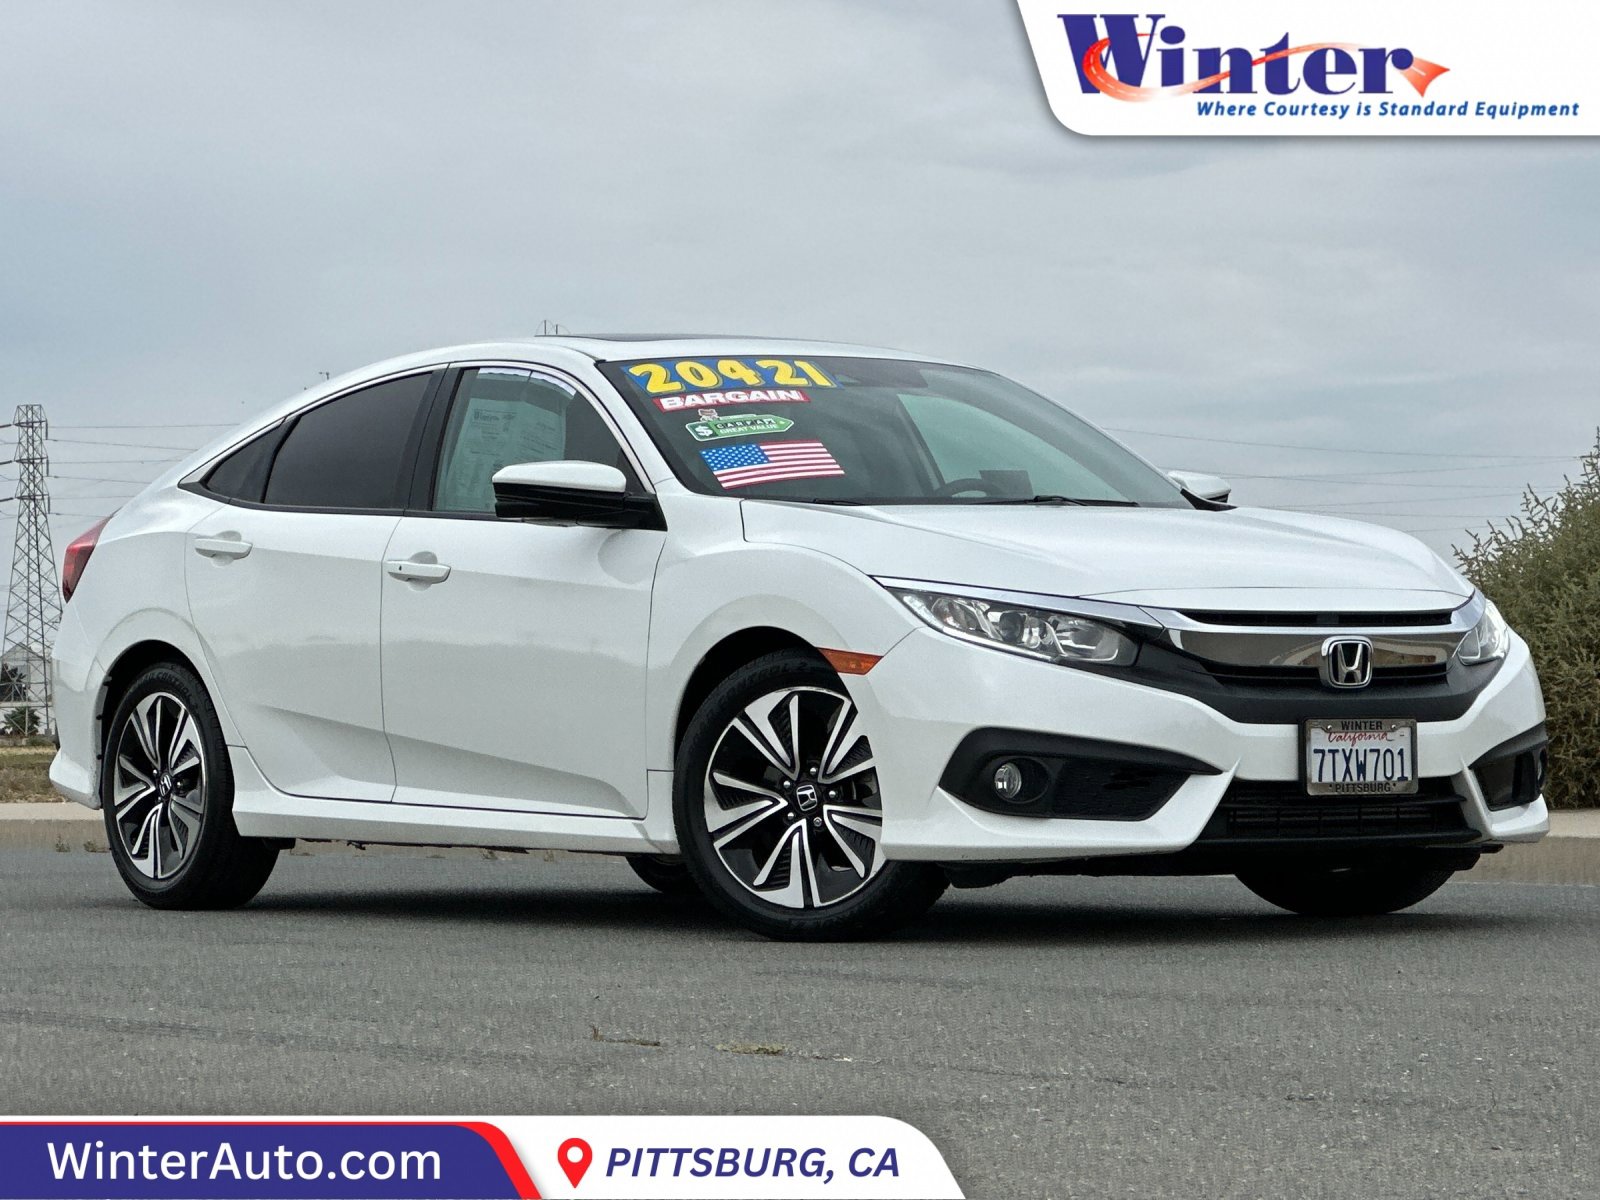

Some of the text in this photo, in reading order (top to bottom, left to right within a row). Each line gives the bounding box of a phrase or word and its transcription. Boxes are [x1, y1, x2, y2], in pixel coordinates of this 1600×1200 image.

[629, 360, 834, 393] 20421
[659, 389, 802, 410] BARGAIN
[715, 417, 776, 428] CARFAX
[719, 423, 778, 434] GREAT VALUE
[1340, 720, 1383, 731] WINTER
[1328, 731, 1393, 747] California
[1313, 748, 1409, 783] 7TXW701
[1335, 782, 1391, 793] PITTSBURG
